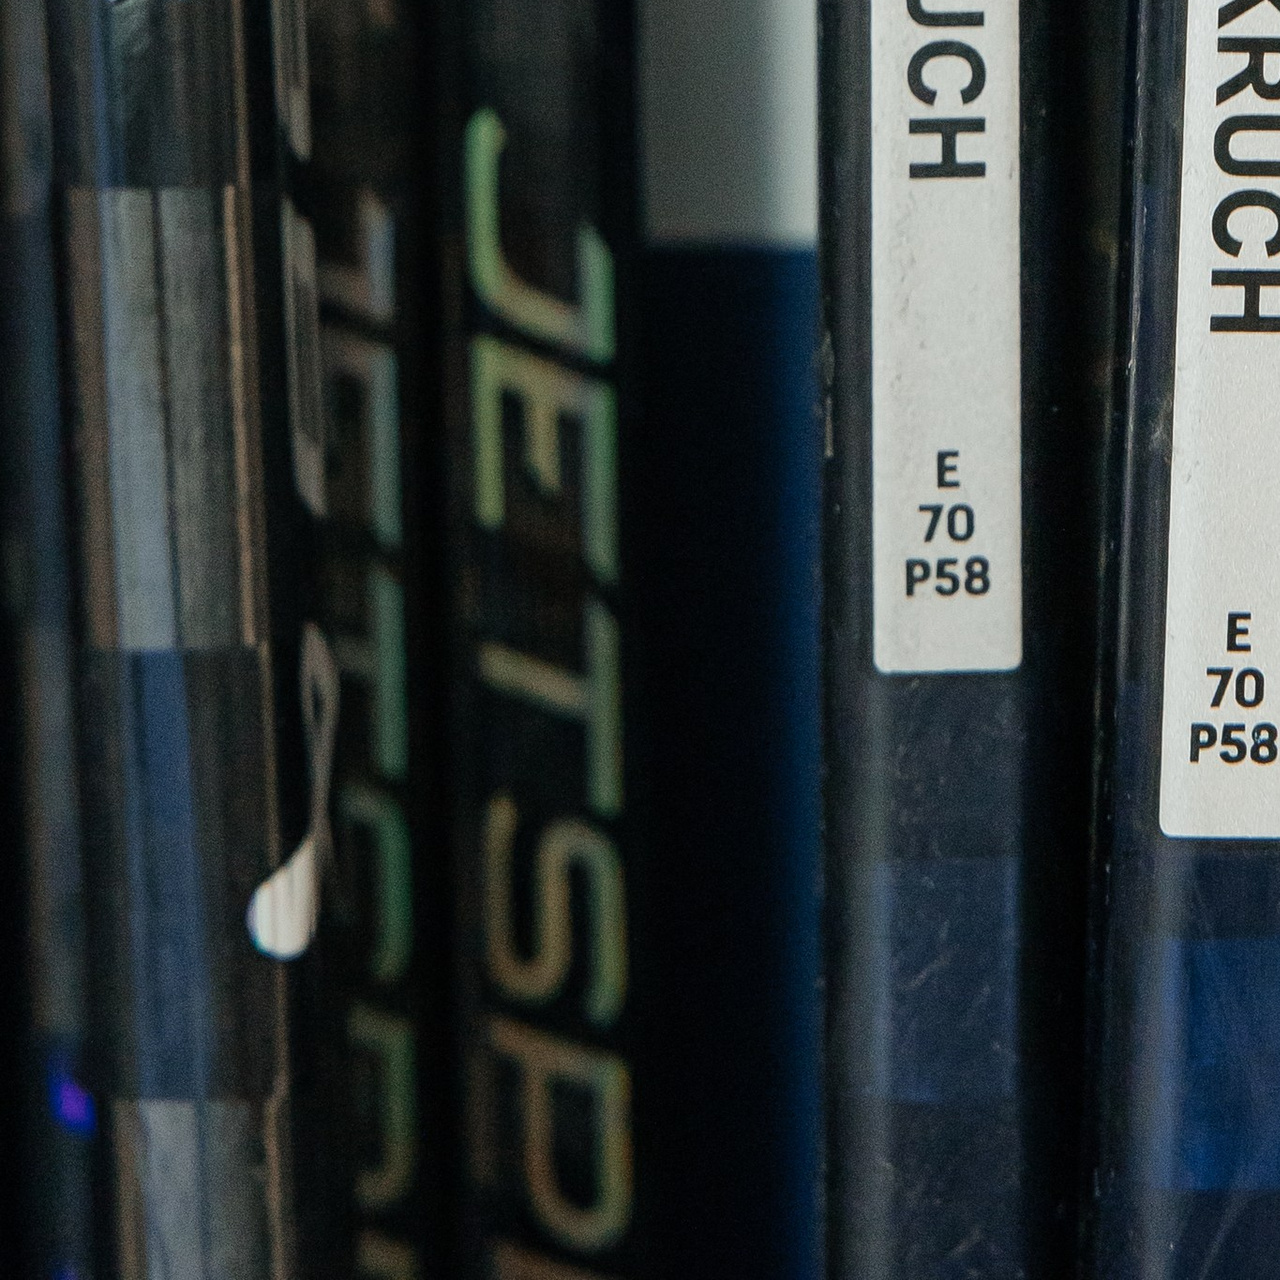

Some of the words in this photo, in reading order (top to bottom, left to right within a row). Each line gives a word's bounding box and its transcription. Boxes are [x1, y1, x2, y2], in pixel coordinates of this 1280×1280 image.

[936, 450, 961, 488] E
[918, 503, 976, 543] 70
[903, 557, 991, 598] P58
[1226, 612, 1252, 652] E
[464, 106, 640, 1280] JETSP
[1204, 667, 1266, 707] 70
[1188, 723, 1279, 765] P58
